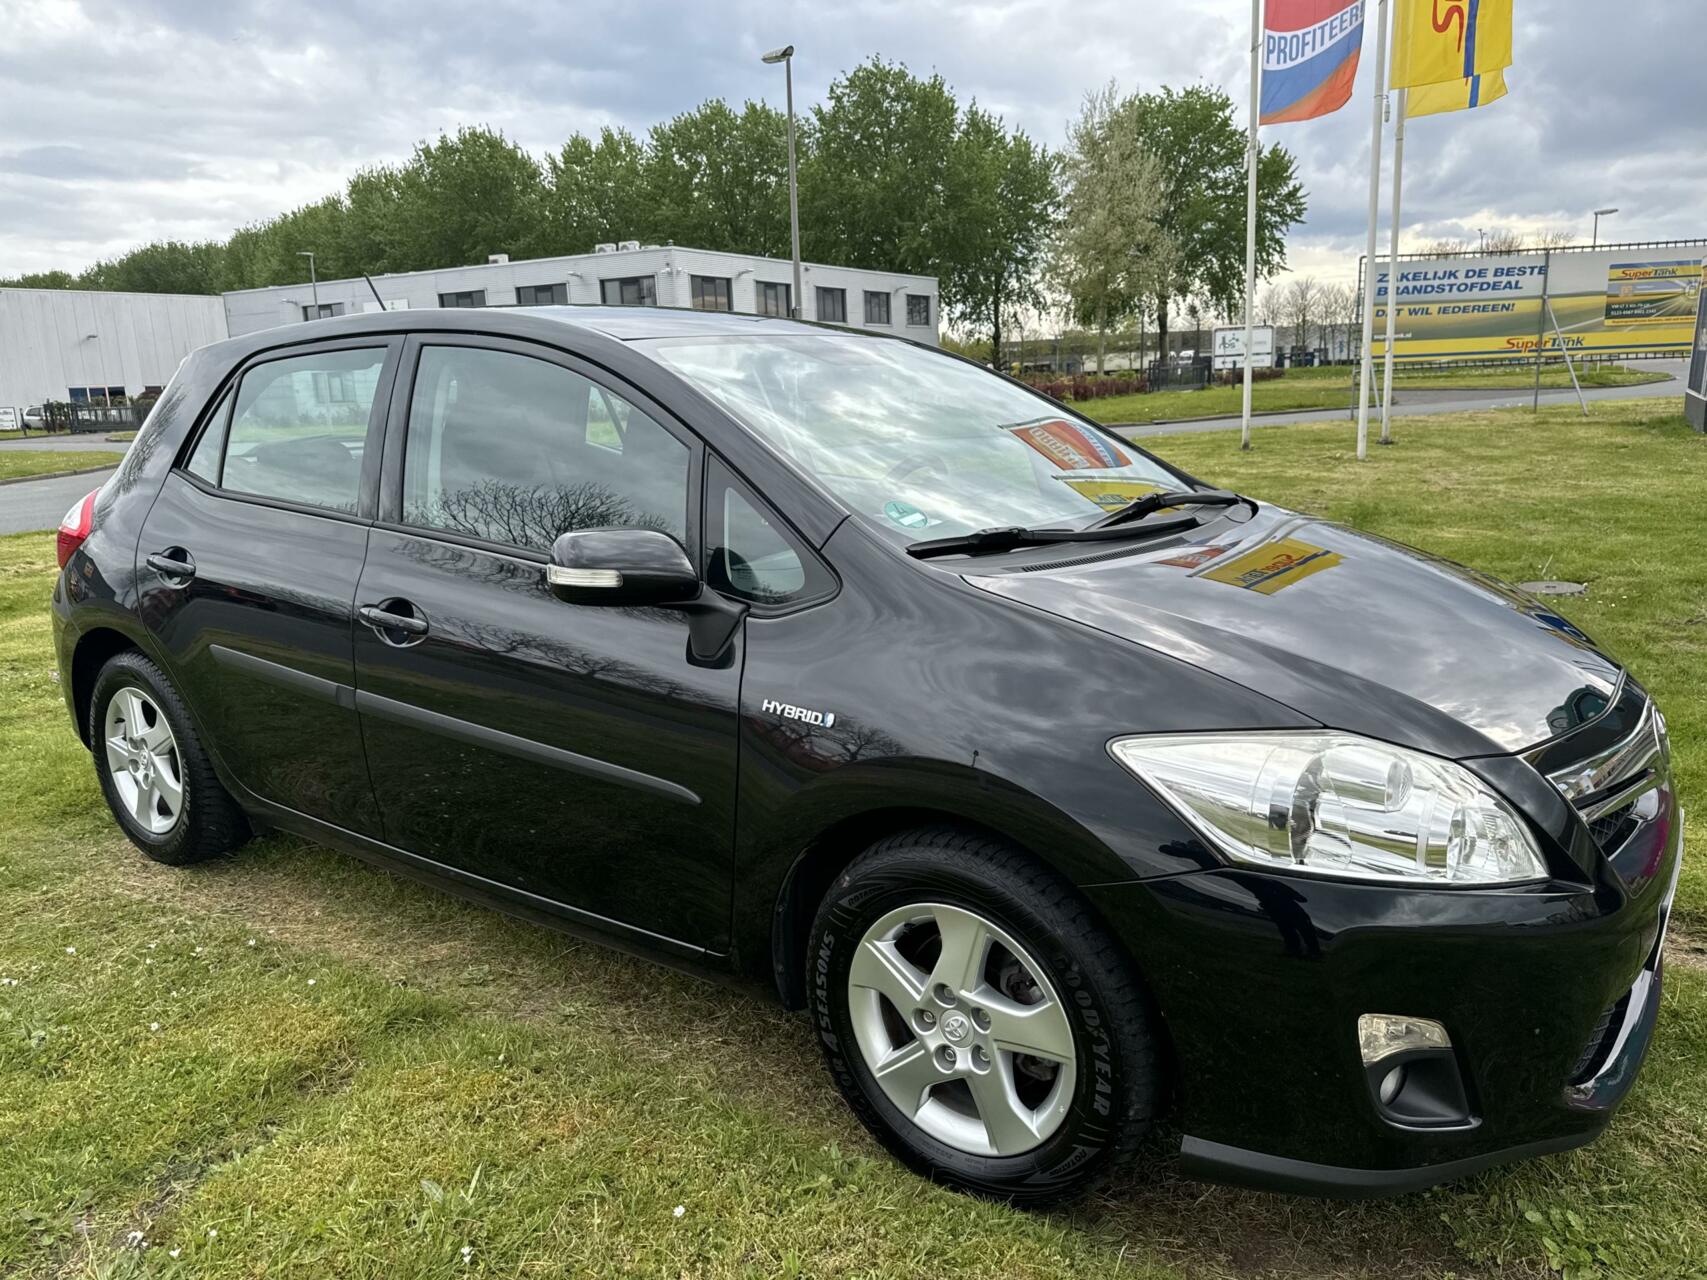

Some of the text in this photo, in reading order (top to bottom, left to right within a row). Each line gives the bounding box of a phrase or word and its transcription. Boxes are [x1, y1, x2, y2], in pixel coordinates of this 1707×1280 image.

[1266, 2, 1364, 65] PROFITEER!
[1377, 265, 1548, 284] ZKELIJK DE BESTE
[1375, 303, 1515, 318] DT WIL IEDEREEN!
[761, 698, 823, 727] HYBRID
